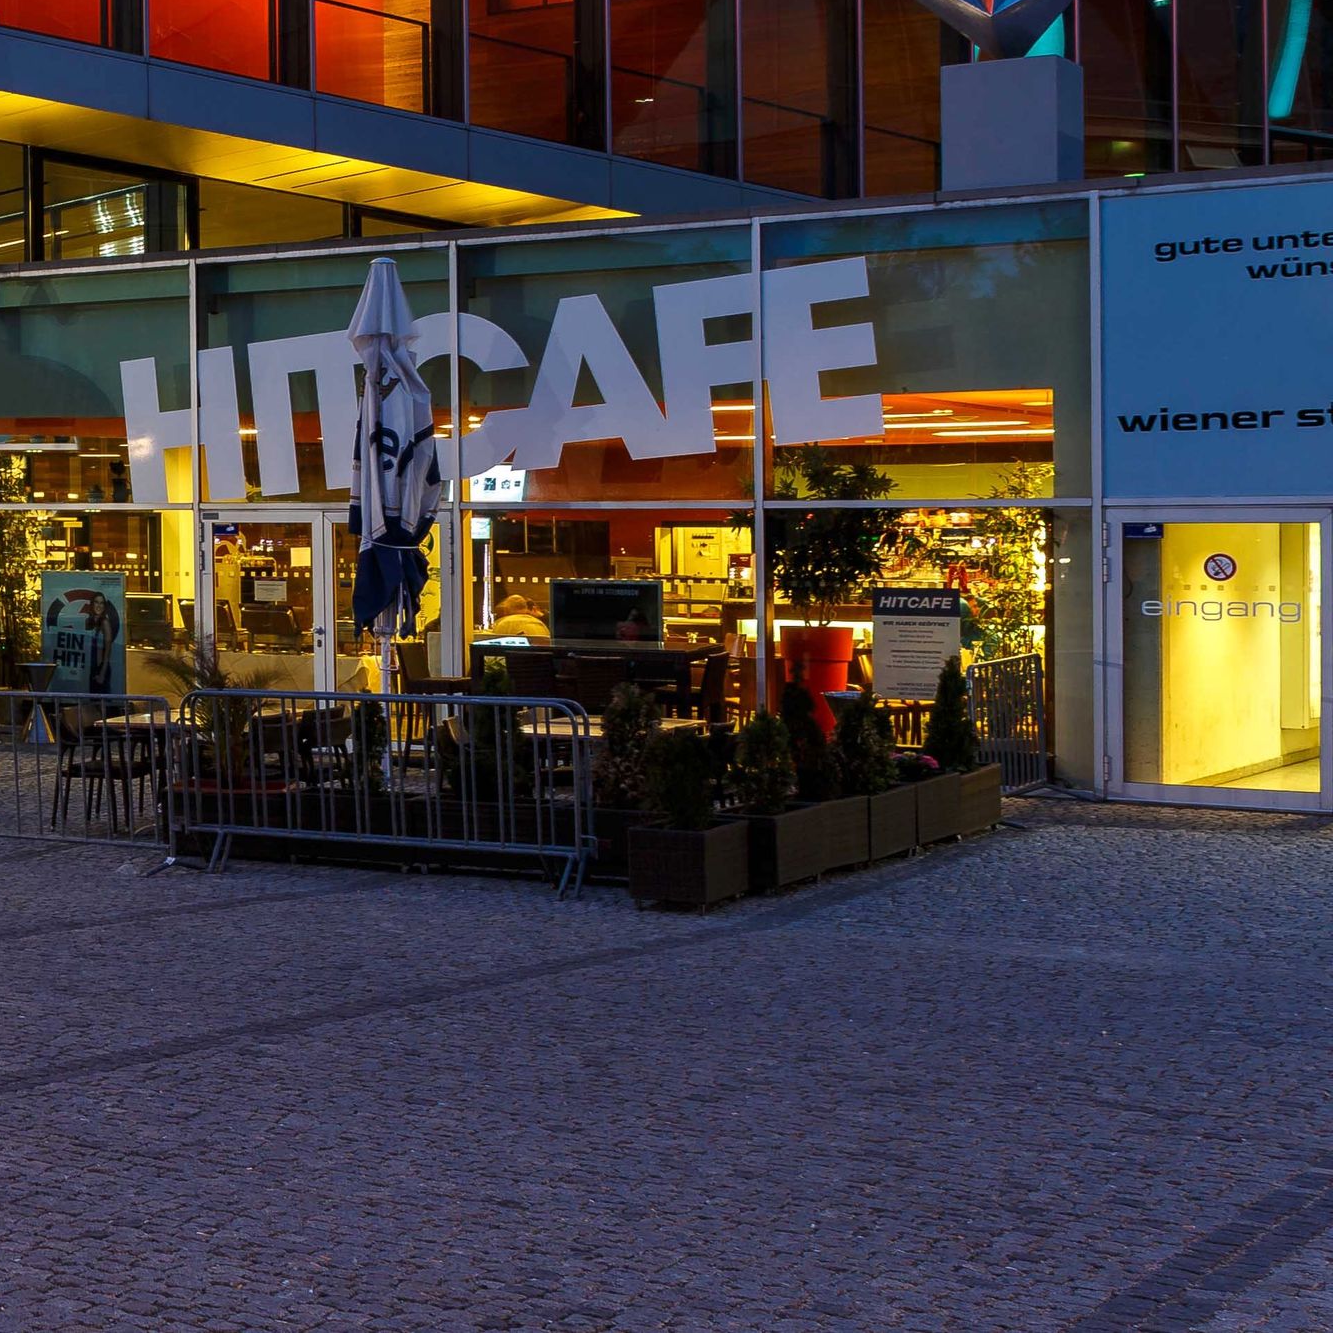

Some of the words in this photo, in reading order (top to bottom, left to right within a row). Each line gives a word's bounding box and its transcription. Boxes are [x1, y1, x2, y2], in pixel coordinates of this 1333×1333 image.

[1154, 236, 1244, 263] gute
[1245, 256, 1333, 280] wün
[1117, 407, 1285, 433] wiener
[879, 596, 953, 609] HITCAFE
[1141, 594, 1301, 623] eingang
[56, 631, 85, 651] EIN
[52, 649, 86, 669] HIT!
